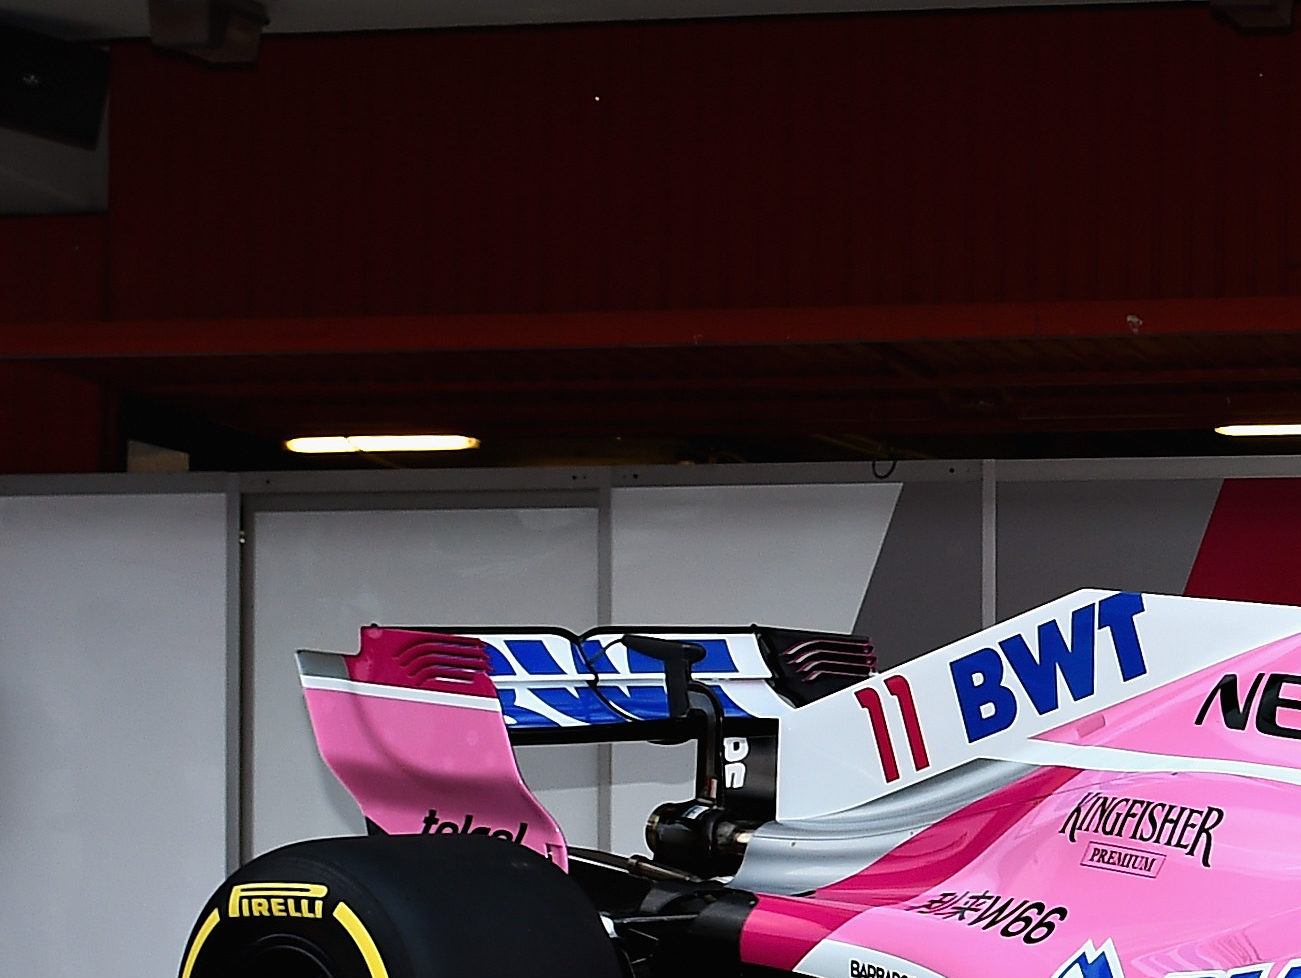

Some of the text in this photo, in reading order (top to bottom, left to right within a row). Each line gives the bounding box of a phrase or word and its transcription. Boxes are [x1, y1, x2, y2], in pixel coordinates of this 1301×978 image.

[948, 591, 1148, 744] BWT
[853, 674, 930, 784] 11
[1058, 792, 1226, 867] KINGFISHER
[1088, 846, 1157, 873] PREMIUM
[228, 882, 328, 919] PIRELLI
